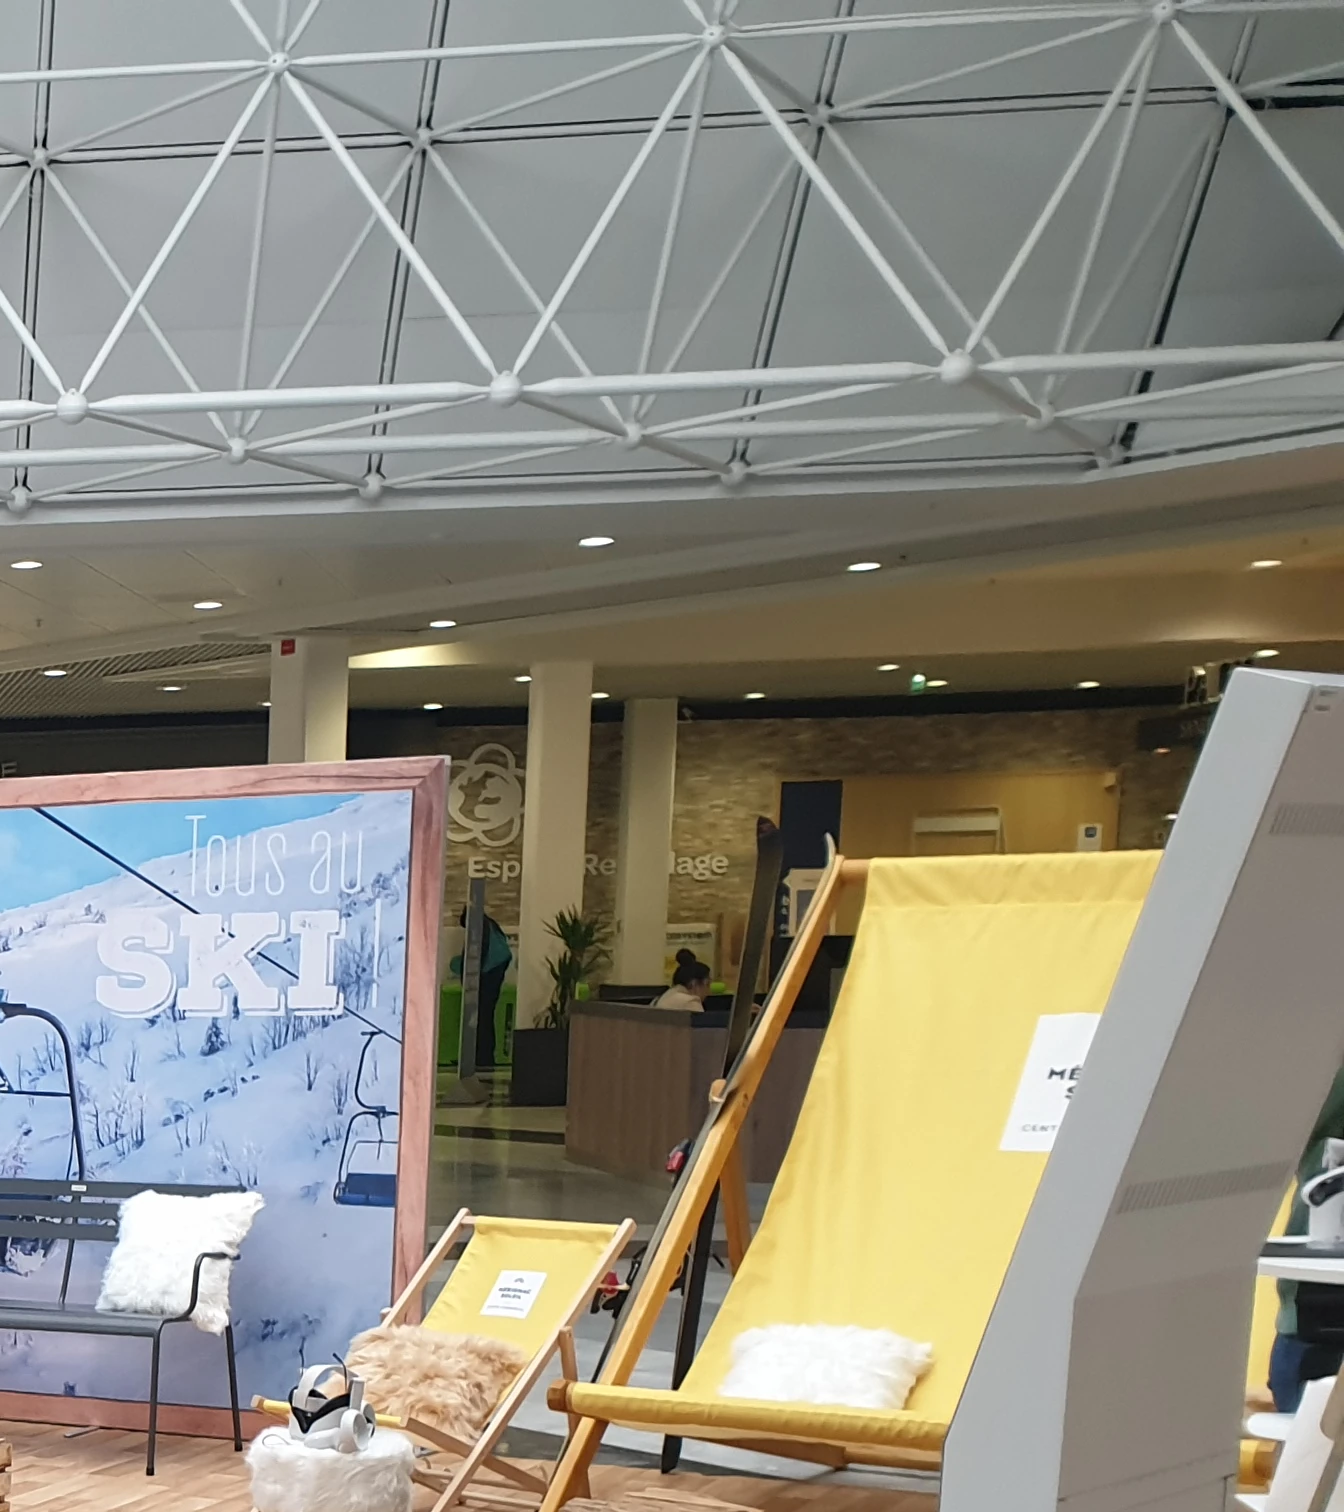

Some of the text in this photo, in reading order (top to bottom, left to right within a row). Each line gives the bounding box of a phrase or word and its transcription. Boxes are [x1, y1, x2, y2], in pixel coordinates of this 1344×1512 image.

[184, 814, 365, 897] Tous au
[94, 909, 346, 1019] SKI
